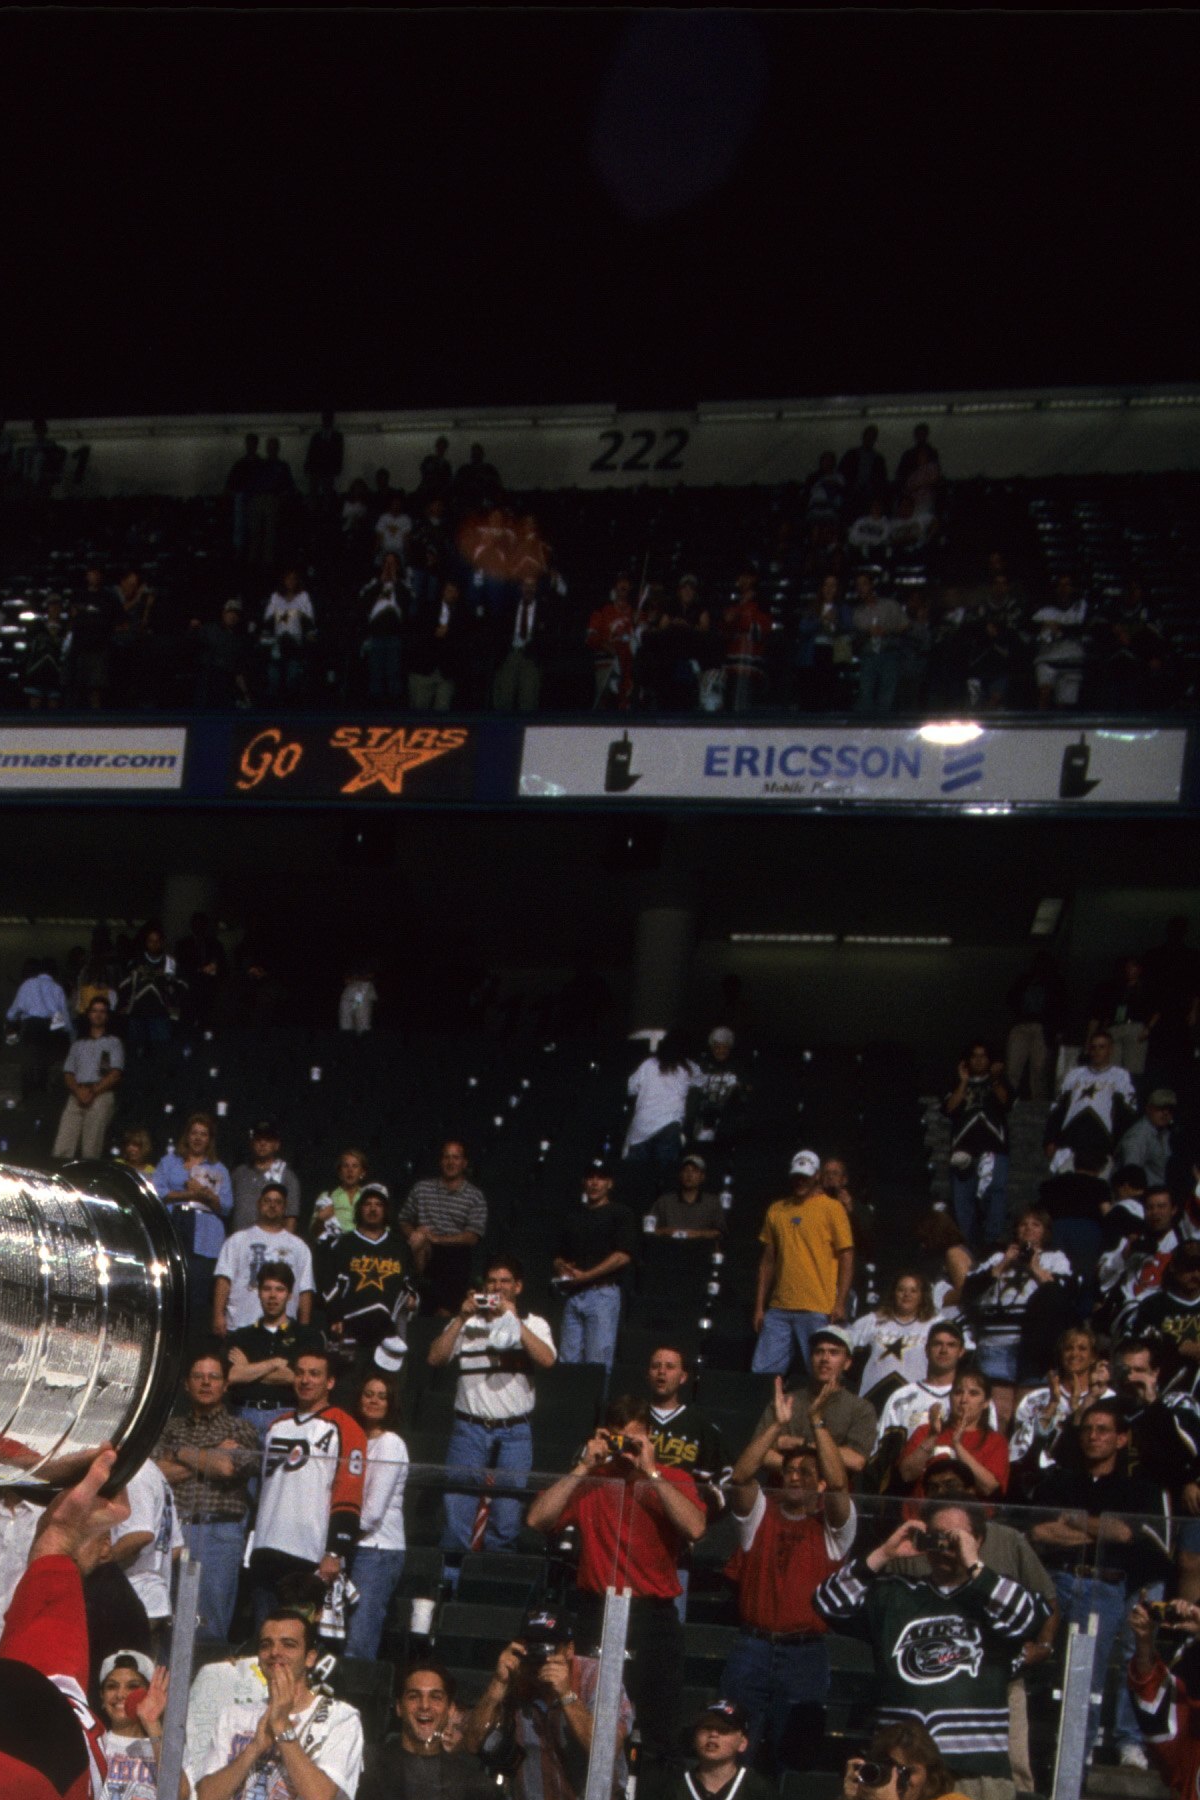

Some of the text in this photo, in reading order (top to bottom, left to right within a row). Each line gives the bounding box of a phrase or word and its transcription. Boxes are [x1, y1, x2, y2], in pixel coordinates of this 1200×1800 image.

[589, 429, 690, 471] 222
[330, 727, 468, 748] STARS
[236, 728, 302, 790] Go
[703, 744, 922, 779] ERICSSON
[316, 1429, 335, 1453] A
